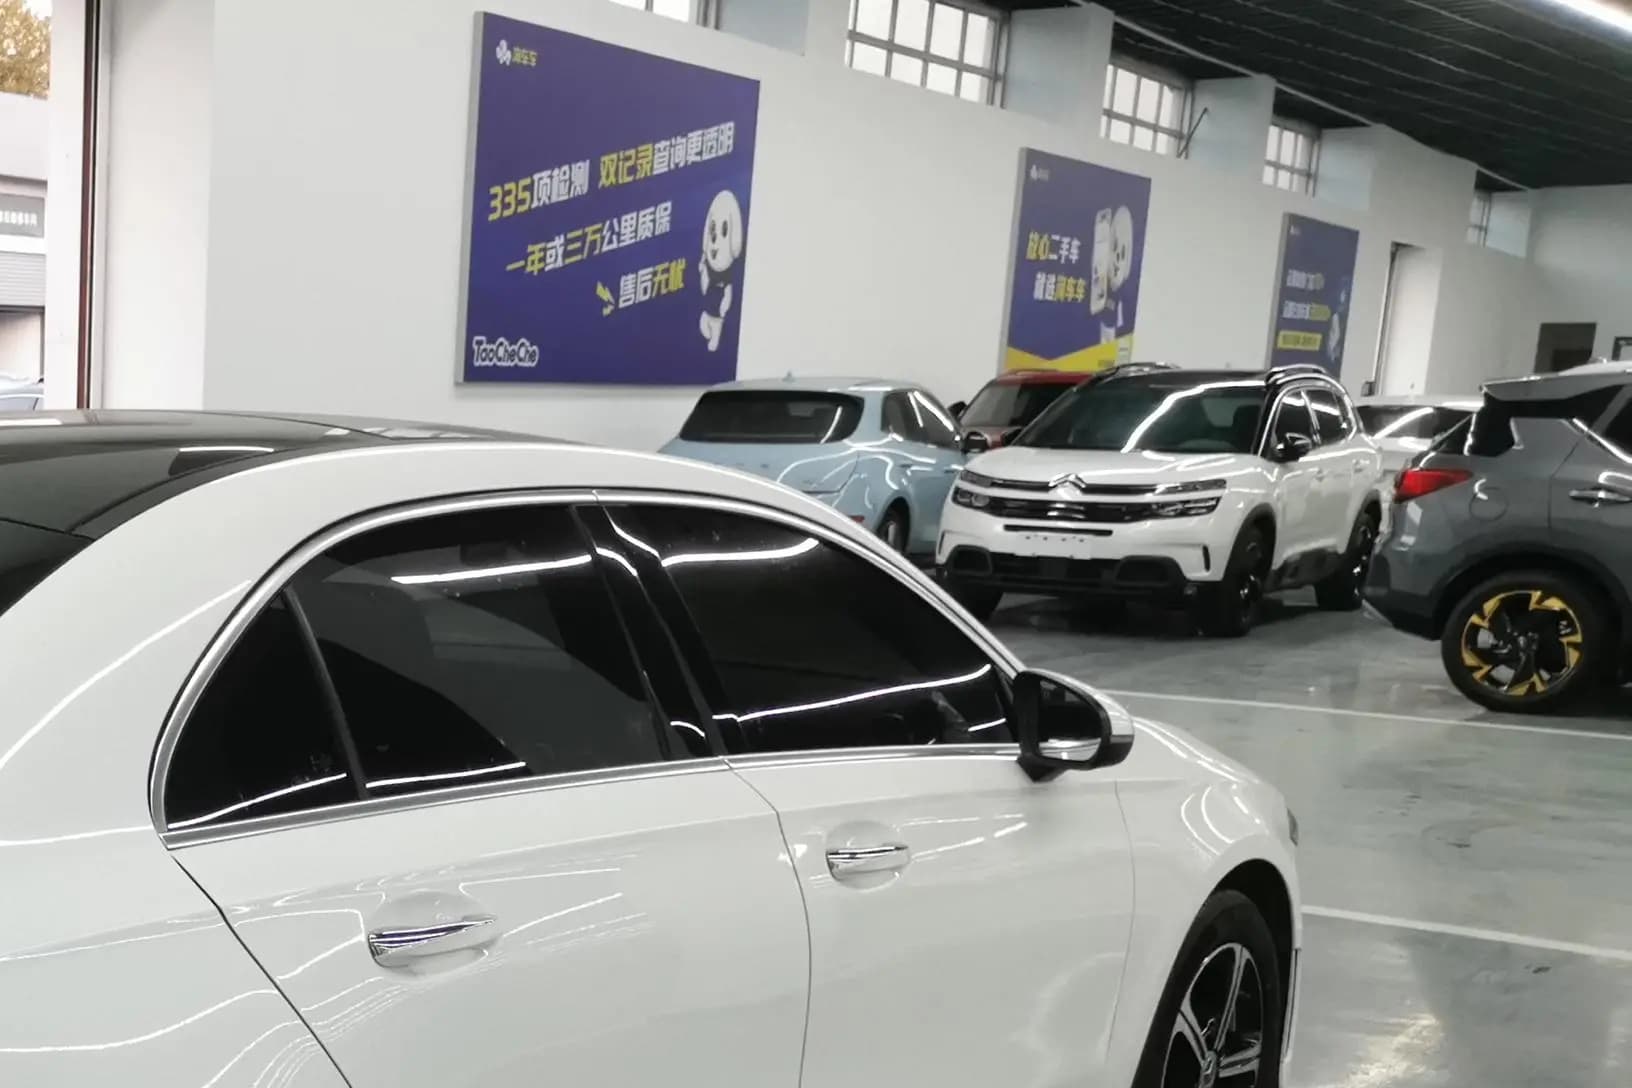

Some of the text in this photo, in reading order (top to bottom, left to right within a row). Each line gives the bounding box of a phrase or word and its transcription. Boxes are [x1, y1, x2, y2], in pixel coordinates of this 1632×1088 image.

[506, 201, 672, 276] 一年或三万公里质保
[473, 336, 539, 367] TaoCheChe
